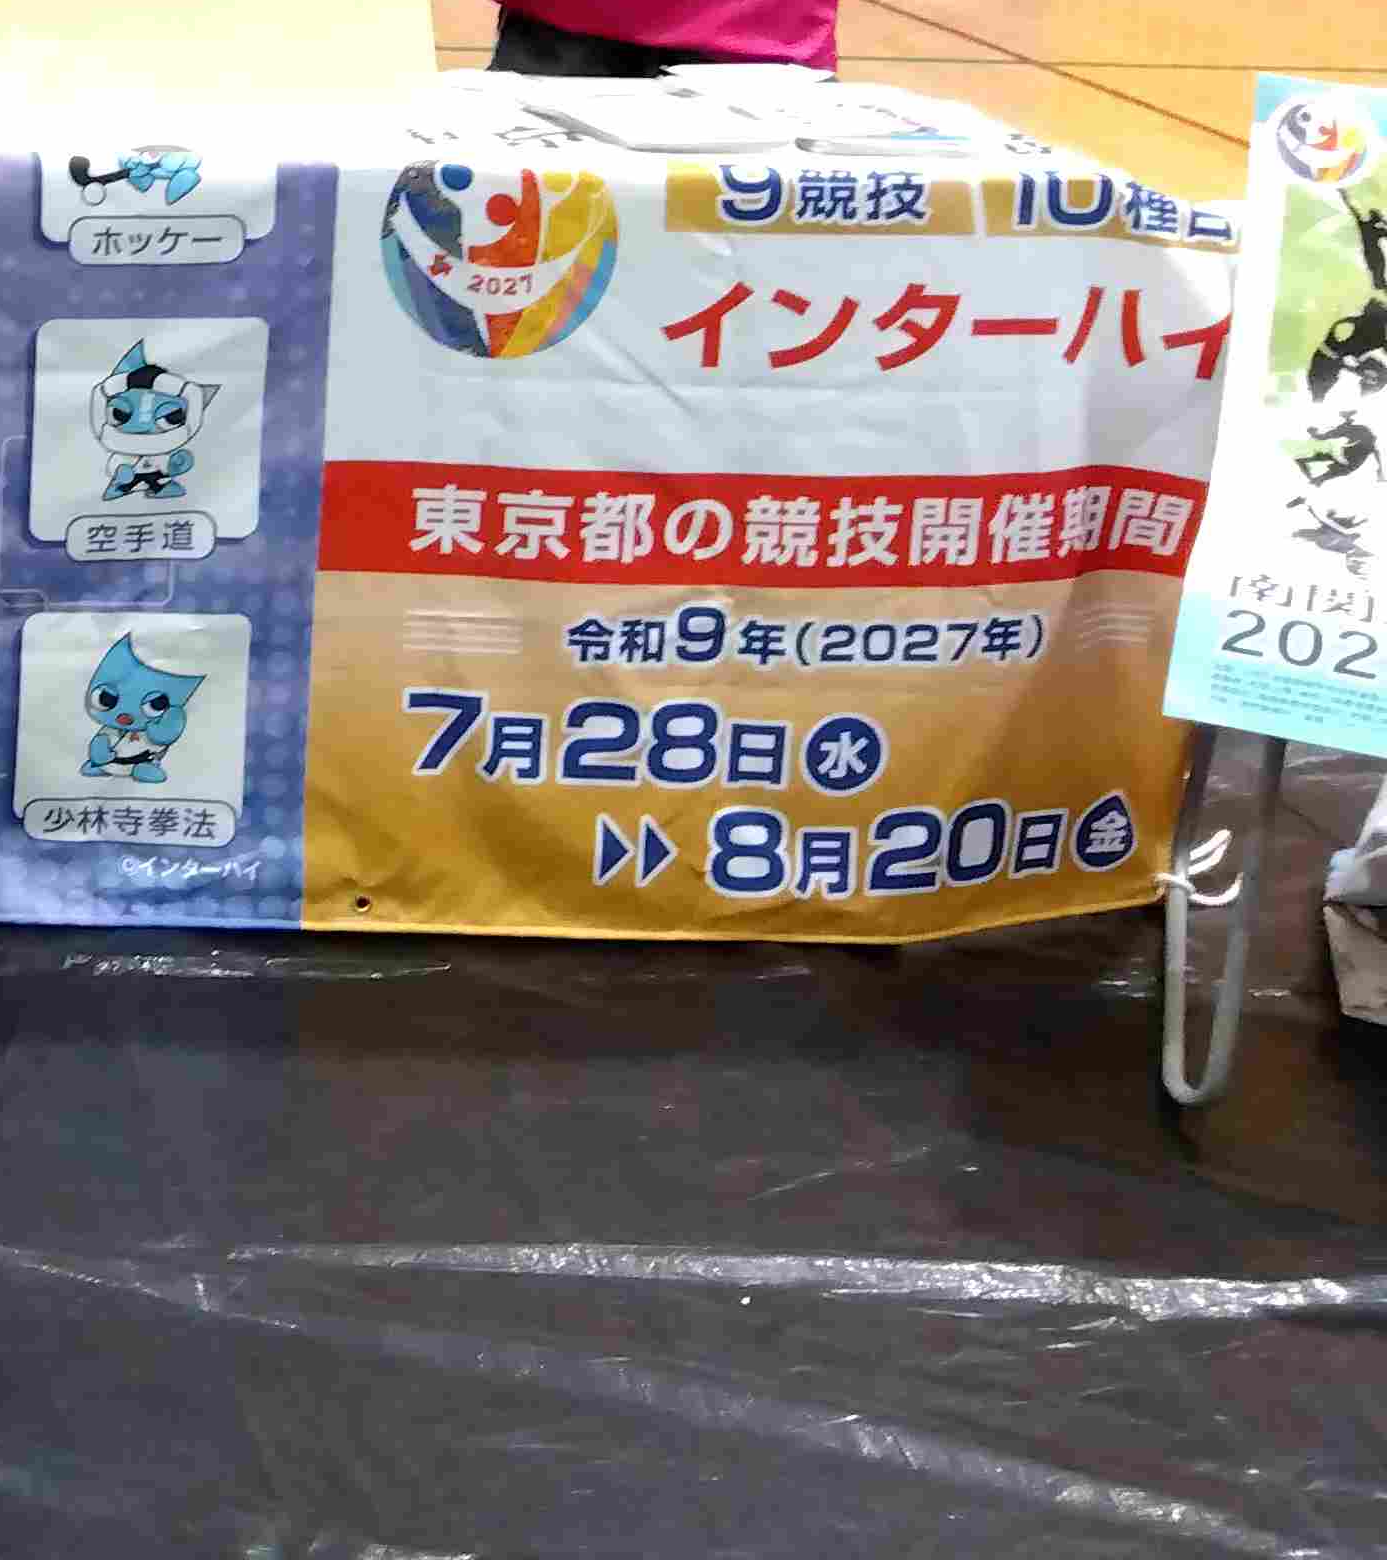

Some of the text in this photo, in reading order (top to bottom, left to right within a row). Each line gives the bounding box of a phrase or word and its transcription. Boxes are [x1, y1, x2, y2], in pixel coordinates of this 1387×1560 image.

[719, 163, 929, 226] 9競技
[90, 224, 223, 258] ホッケー
[467, 272, 532, 295] 2027
[663, 281, 1232, 382] インターハイ
[86, 520, 196, 552] 空手道
[409, 484, 1194, 568] 東京都の競技開催期間
[42, 805, 218, 840] 少林寺拳法
